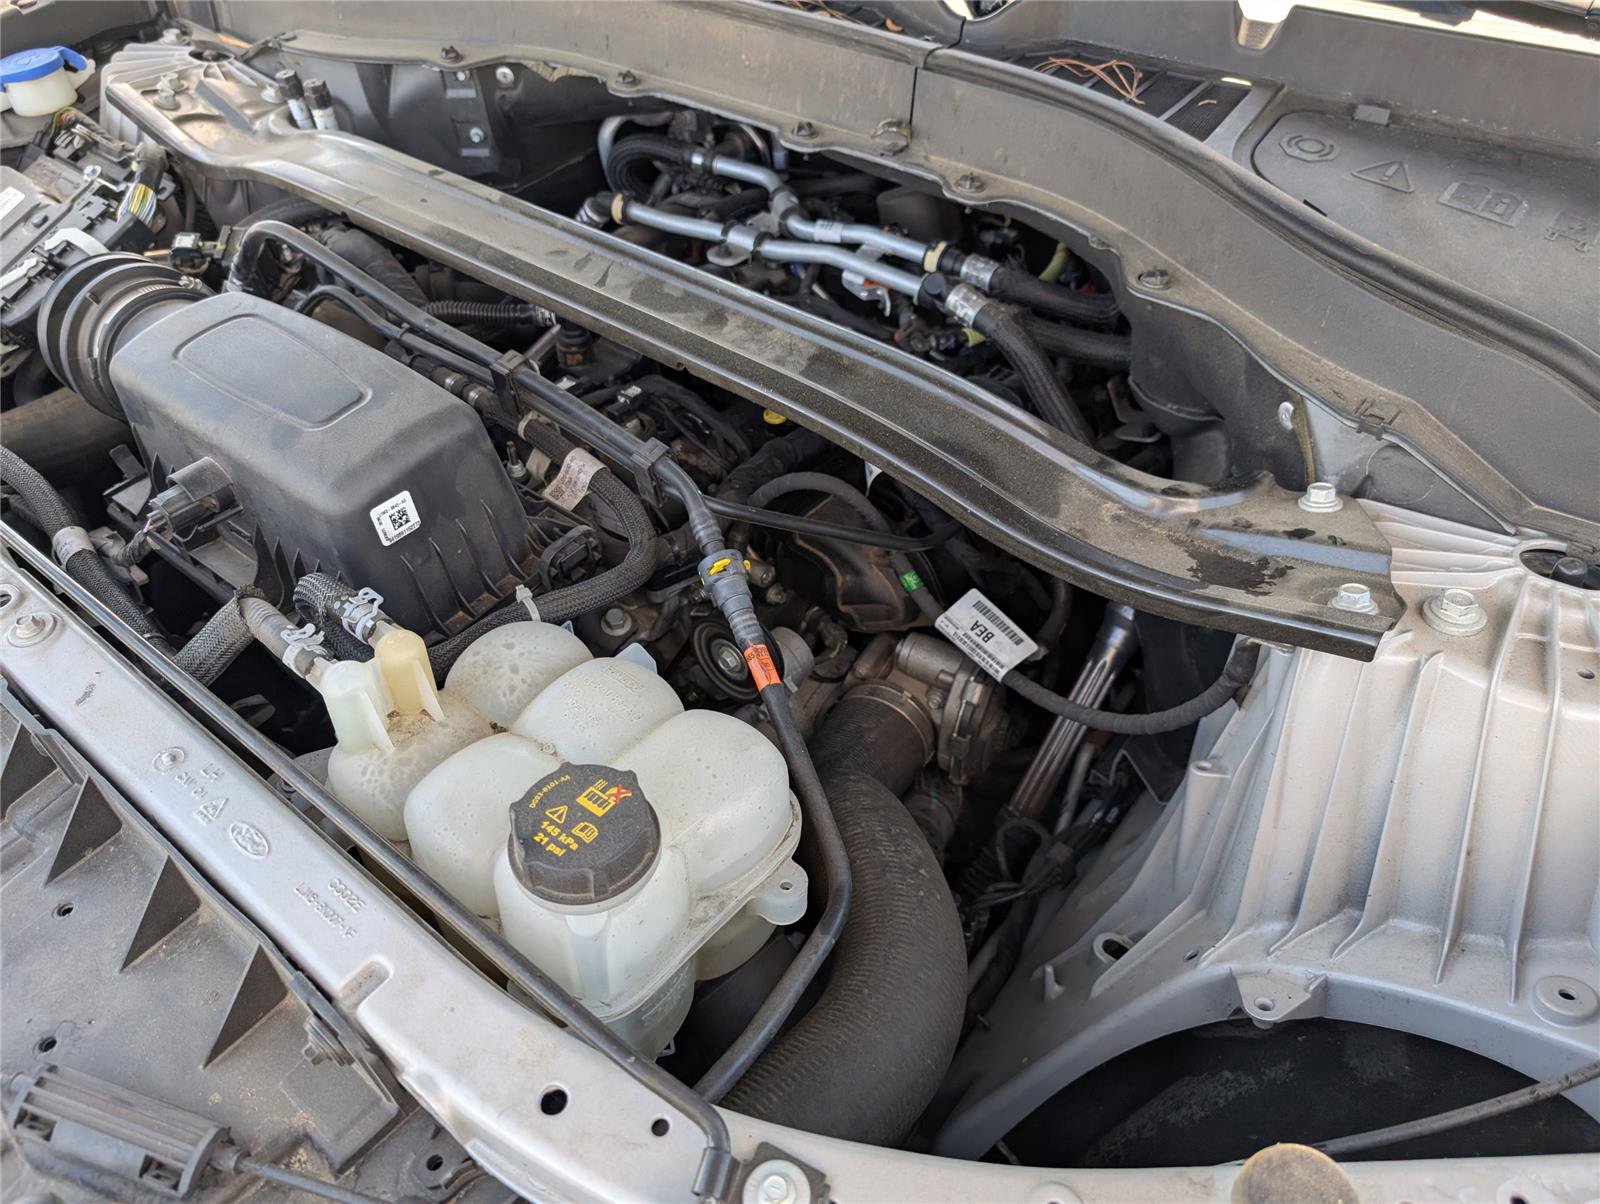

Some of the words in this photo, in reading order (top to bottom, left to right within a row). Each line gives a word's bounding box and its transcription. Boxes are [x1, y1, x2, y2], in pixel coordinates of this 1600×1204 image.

[969, 620, 995, 644] BEA
[533, 832, 549, 845] 21
[545, 843, 567, 857] psi
[541, 821, 561, 837] 145
[558, 833, 579, 851] kPa
